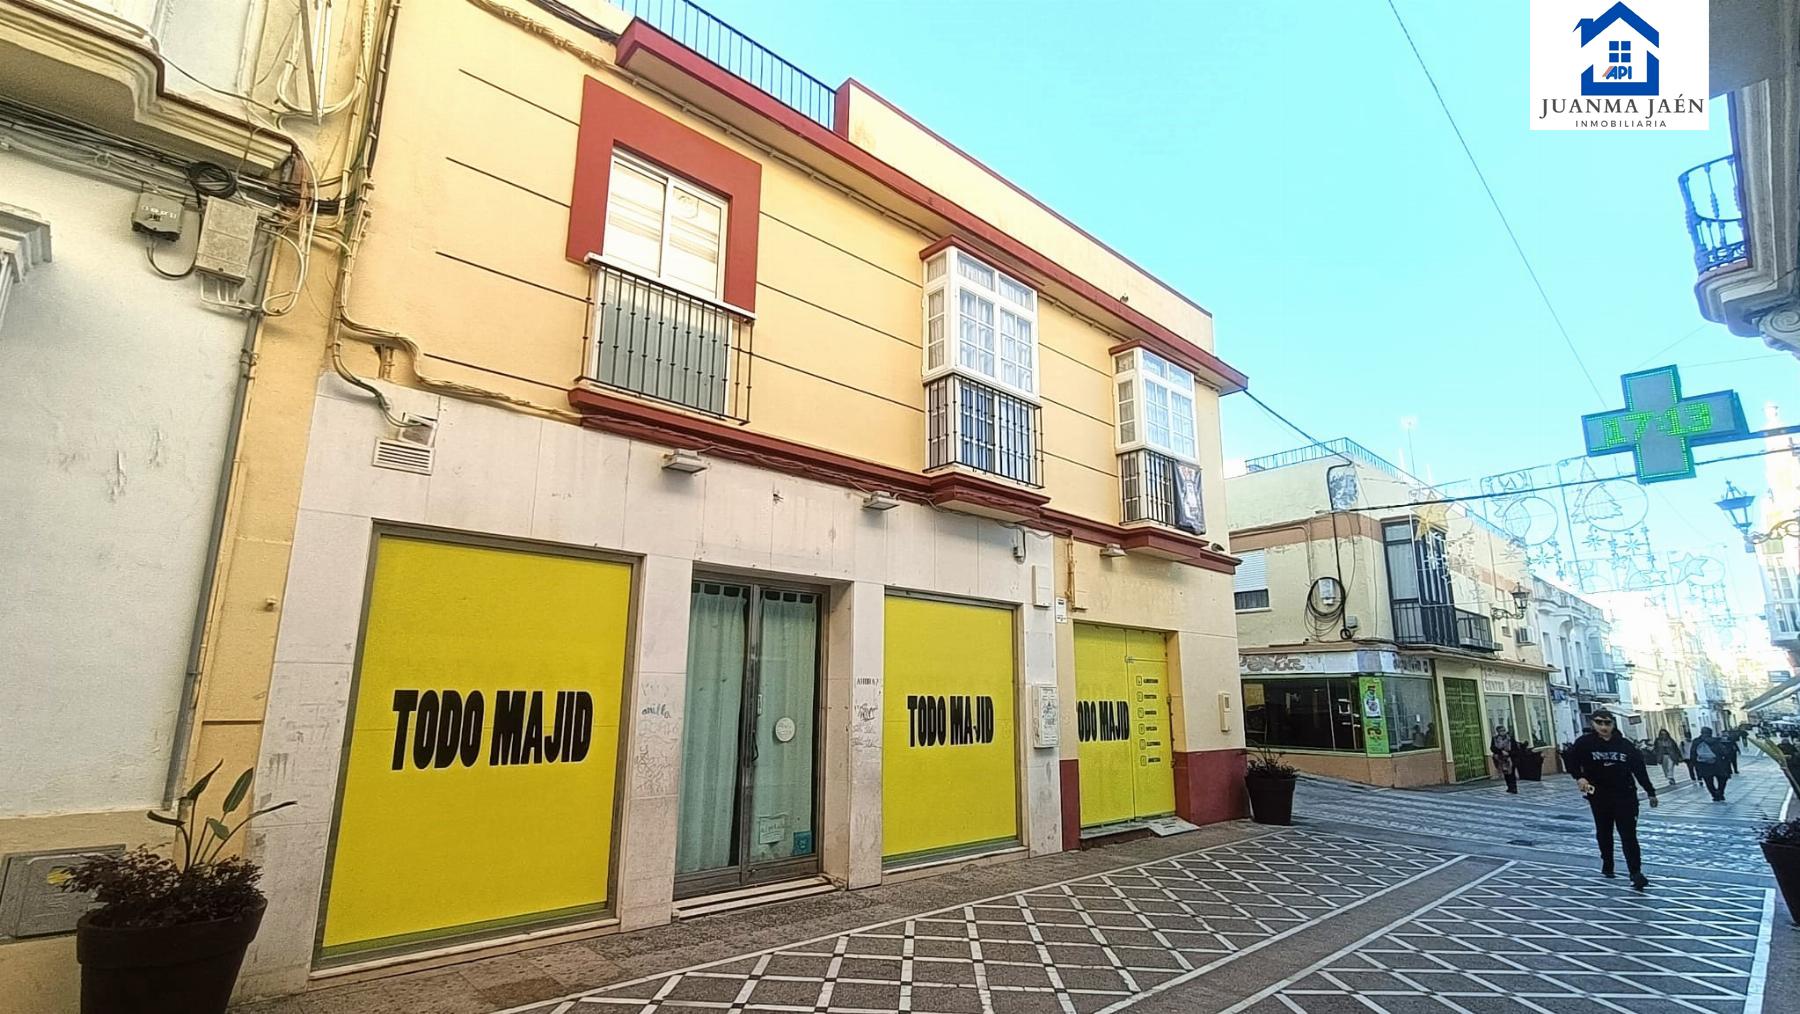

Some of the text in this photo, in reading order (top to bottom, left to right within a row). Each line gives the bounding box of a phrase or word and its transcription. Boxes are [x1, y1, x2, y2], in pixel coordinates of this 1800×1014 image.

[1602, 401, 1713, 445] 17:13
[391, 689, 594, 771] TODO MAJID
[907, 695, 947, 748] TODO
[949, 695, 994, 746] MAJID
[1076, 700, 1097, 742] ODO
[1098, 700, 1130, 742] MAJID
